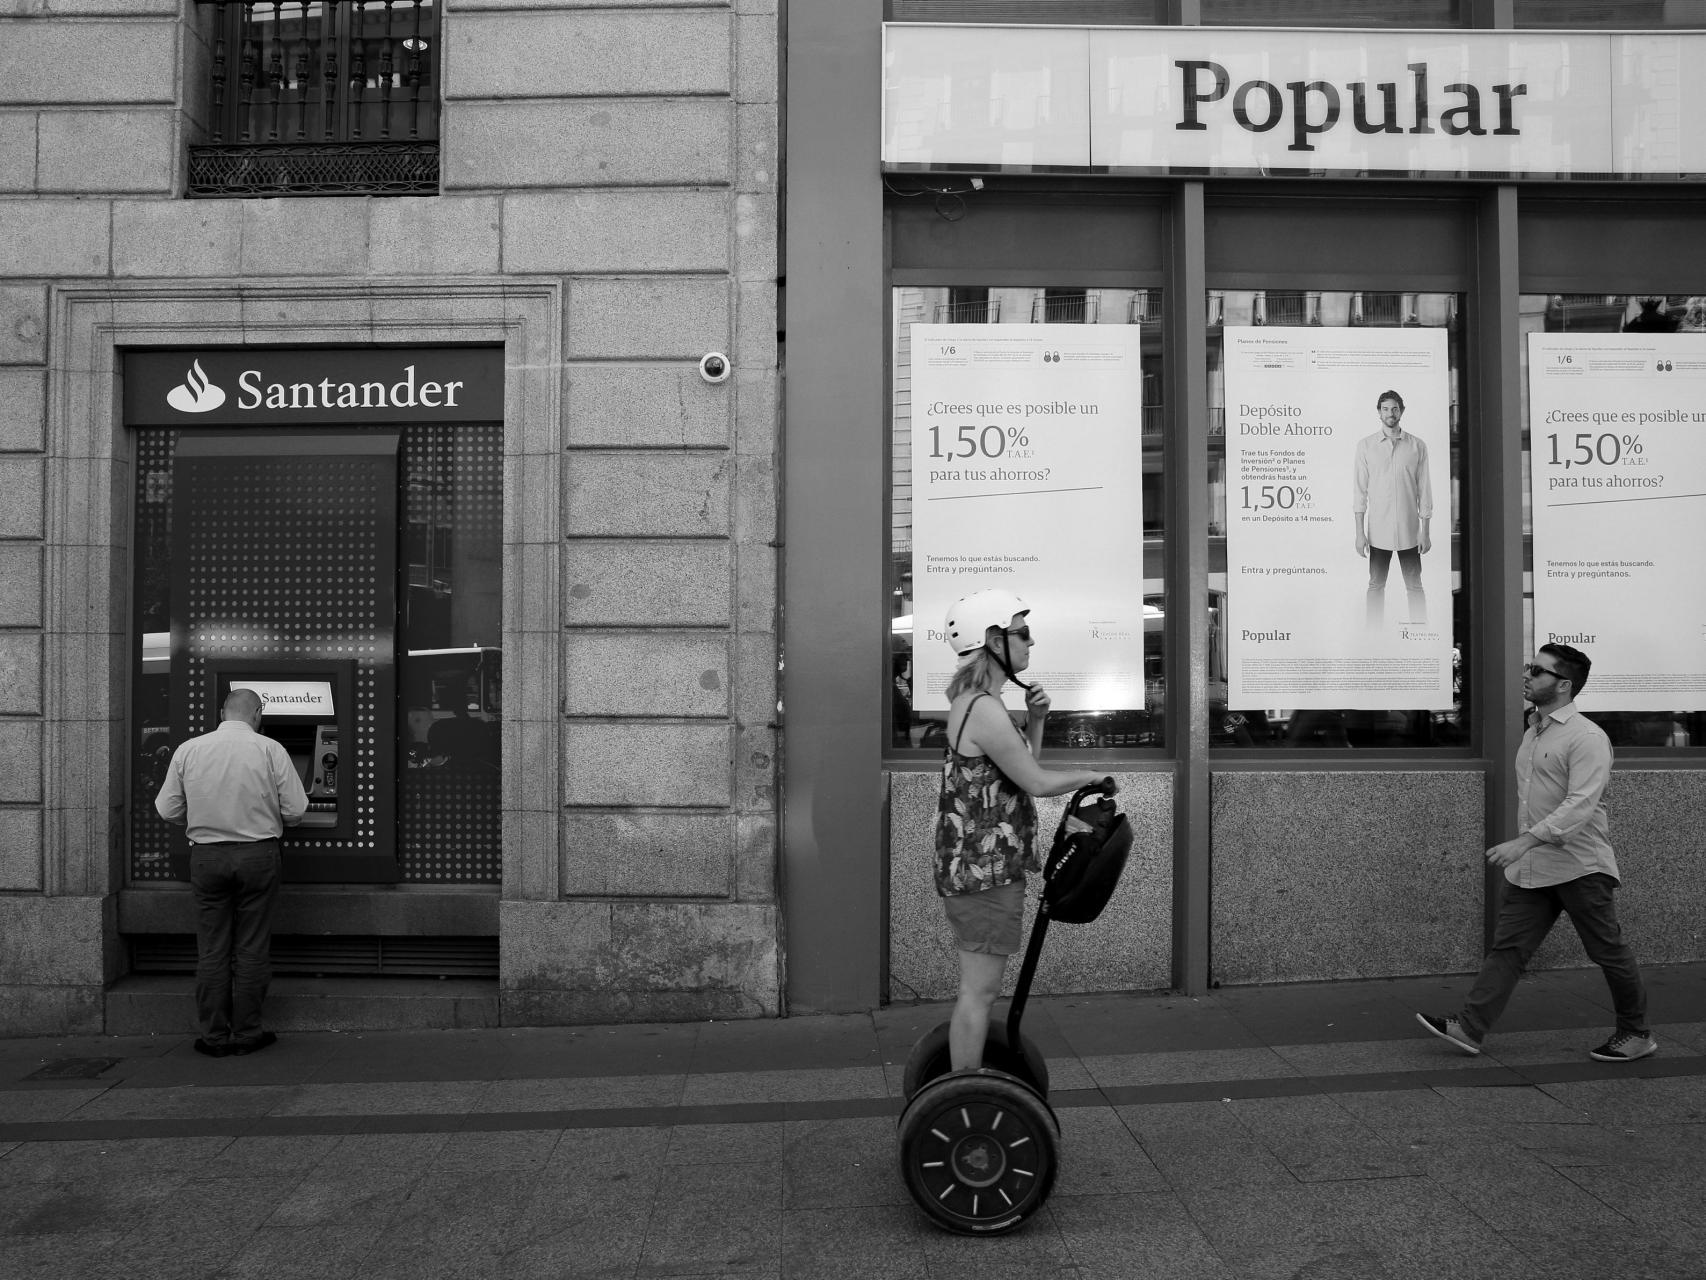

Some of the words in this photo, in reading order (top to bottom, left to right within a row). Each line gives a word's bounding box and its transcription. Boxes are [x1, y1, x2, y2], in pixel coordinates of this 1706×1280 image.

[1175, 60, 1526, 151] Popular
[940, 346, 956, 355] 1/6
[1558, 355, 1572, 364] 1/6
[238, 365, 463, 409] Santander
[927, 401, 972, 416] ¿Crees
[976, 404, 1003, 417] que
[1006, 404, 1021, 415] es
[1025, 401, 1076, 417] posible
[1080, 404, 1098, 415] un
[1240, 404, 1301, 419] Depósito
[1546, 410, 1589, 424] ¿Crees
[1593, 412, 1618, 425] que
[1622, 412, 1635, 423] es
[1640, 410, 1688, 425] posible
[1240, 423, 1280, 436] Doble
[1284, 423, 1332, 436] Ahorro
[929, 425, 1029, 462] 1,50%
[1547, 433, 1643, 469] 1,50%
[930, 469, 960, 483] para
[965, 469, 986, 480] tus
[990, 468, 1050, 480] ahorros?
[1549, 476, 1578, 489] para
[1582, 476, 1602, 487] tus
[1606, 475, 1664, 487] ahorros?
[1241, 486, 1311, 512] 1,50%
[1263, 515, 1292, 523] Depósito
[927, 565, 949, 573] Entra
[1241, 566, 1263, 574] Entra
[1265, 568, 1271, 576] y
[1273, 566, 1327, 576] pregúntanos.
[1578, 570, 1631, 579] pregúntanos.
[1242, 630, 1291, 643] Popular
[1548, 633, 1596, 645] Popular
[262, 693, 322, 703] Santander
